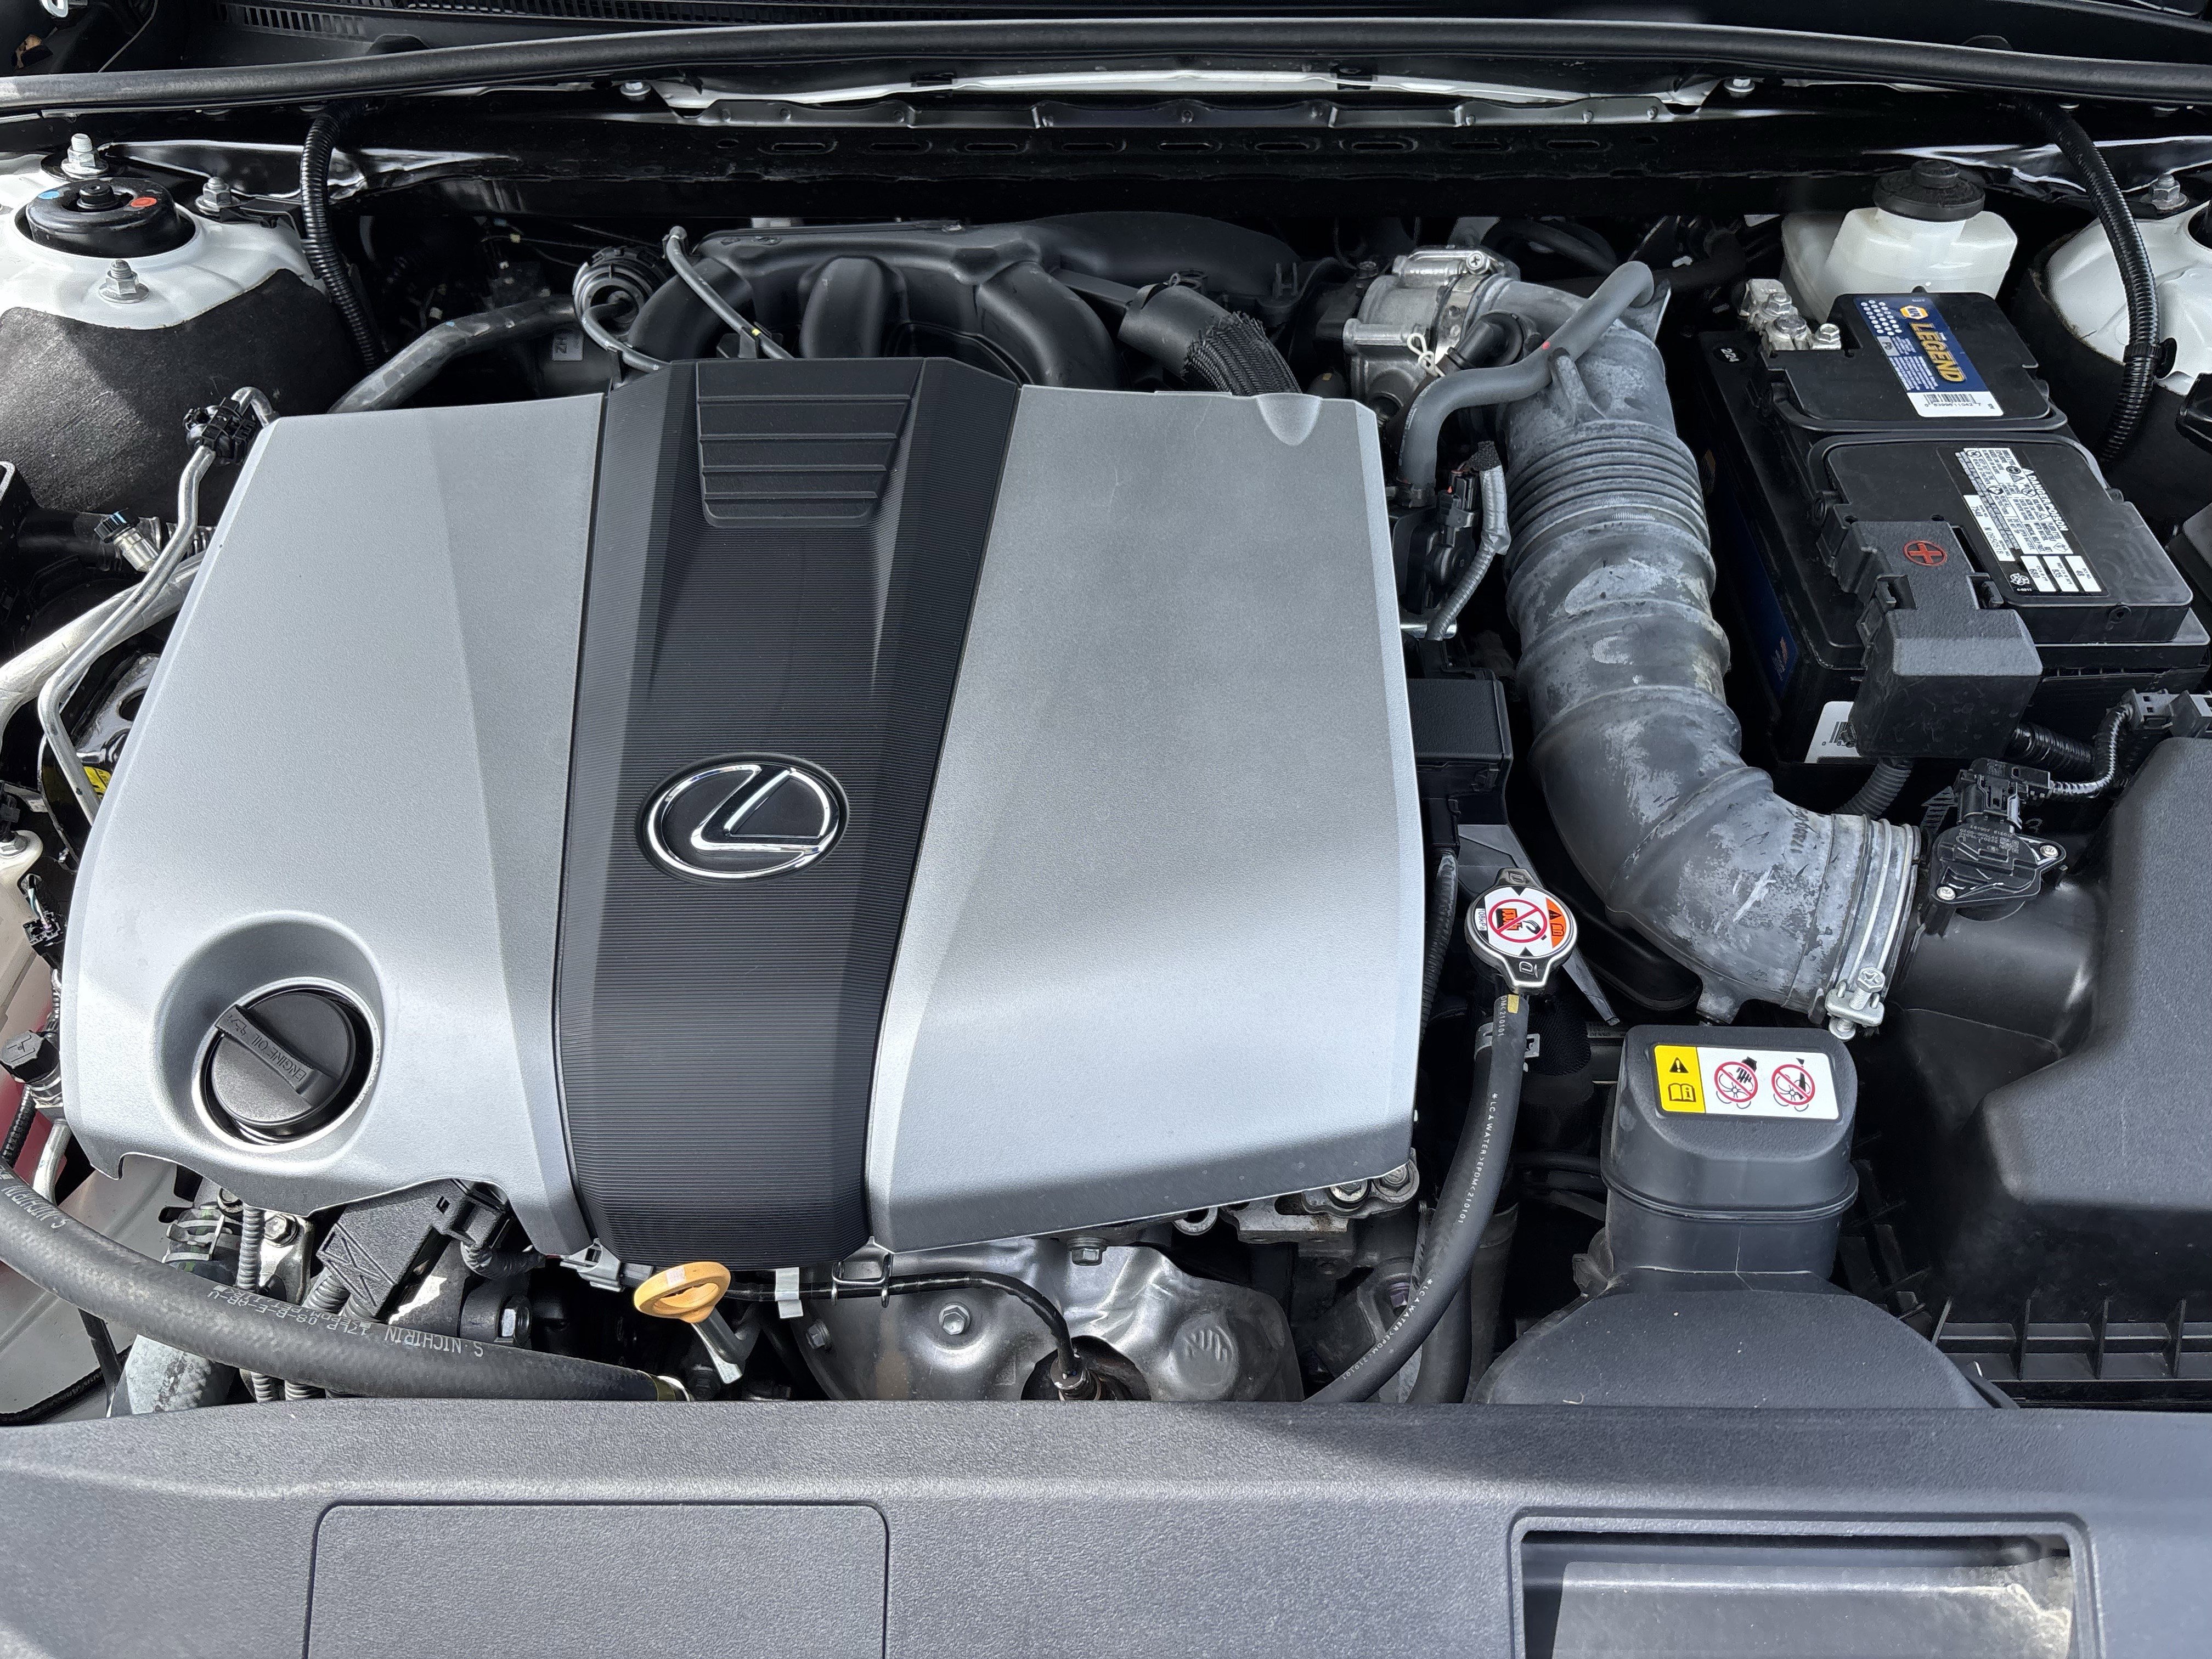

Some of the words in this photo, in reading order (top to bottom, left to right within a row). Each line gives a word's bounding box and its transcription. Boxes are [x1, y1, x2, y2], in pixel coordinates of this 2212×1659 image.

[1910, 323, 1966, 382] LEGEND
[2027, 476, 2069, 531] DANGER/POISON
[2028, 569, 2040, 577] 680
[1477, 909, 1486, 930] 108kPa
[252, 1032, 268, 1051] OIL
[266, 1047, 307, 1082] ENGINE
